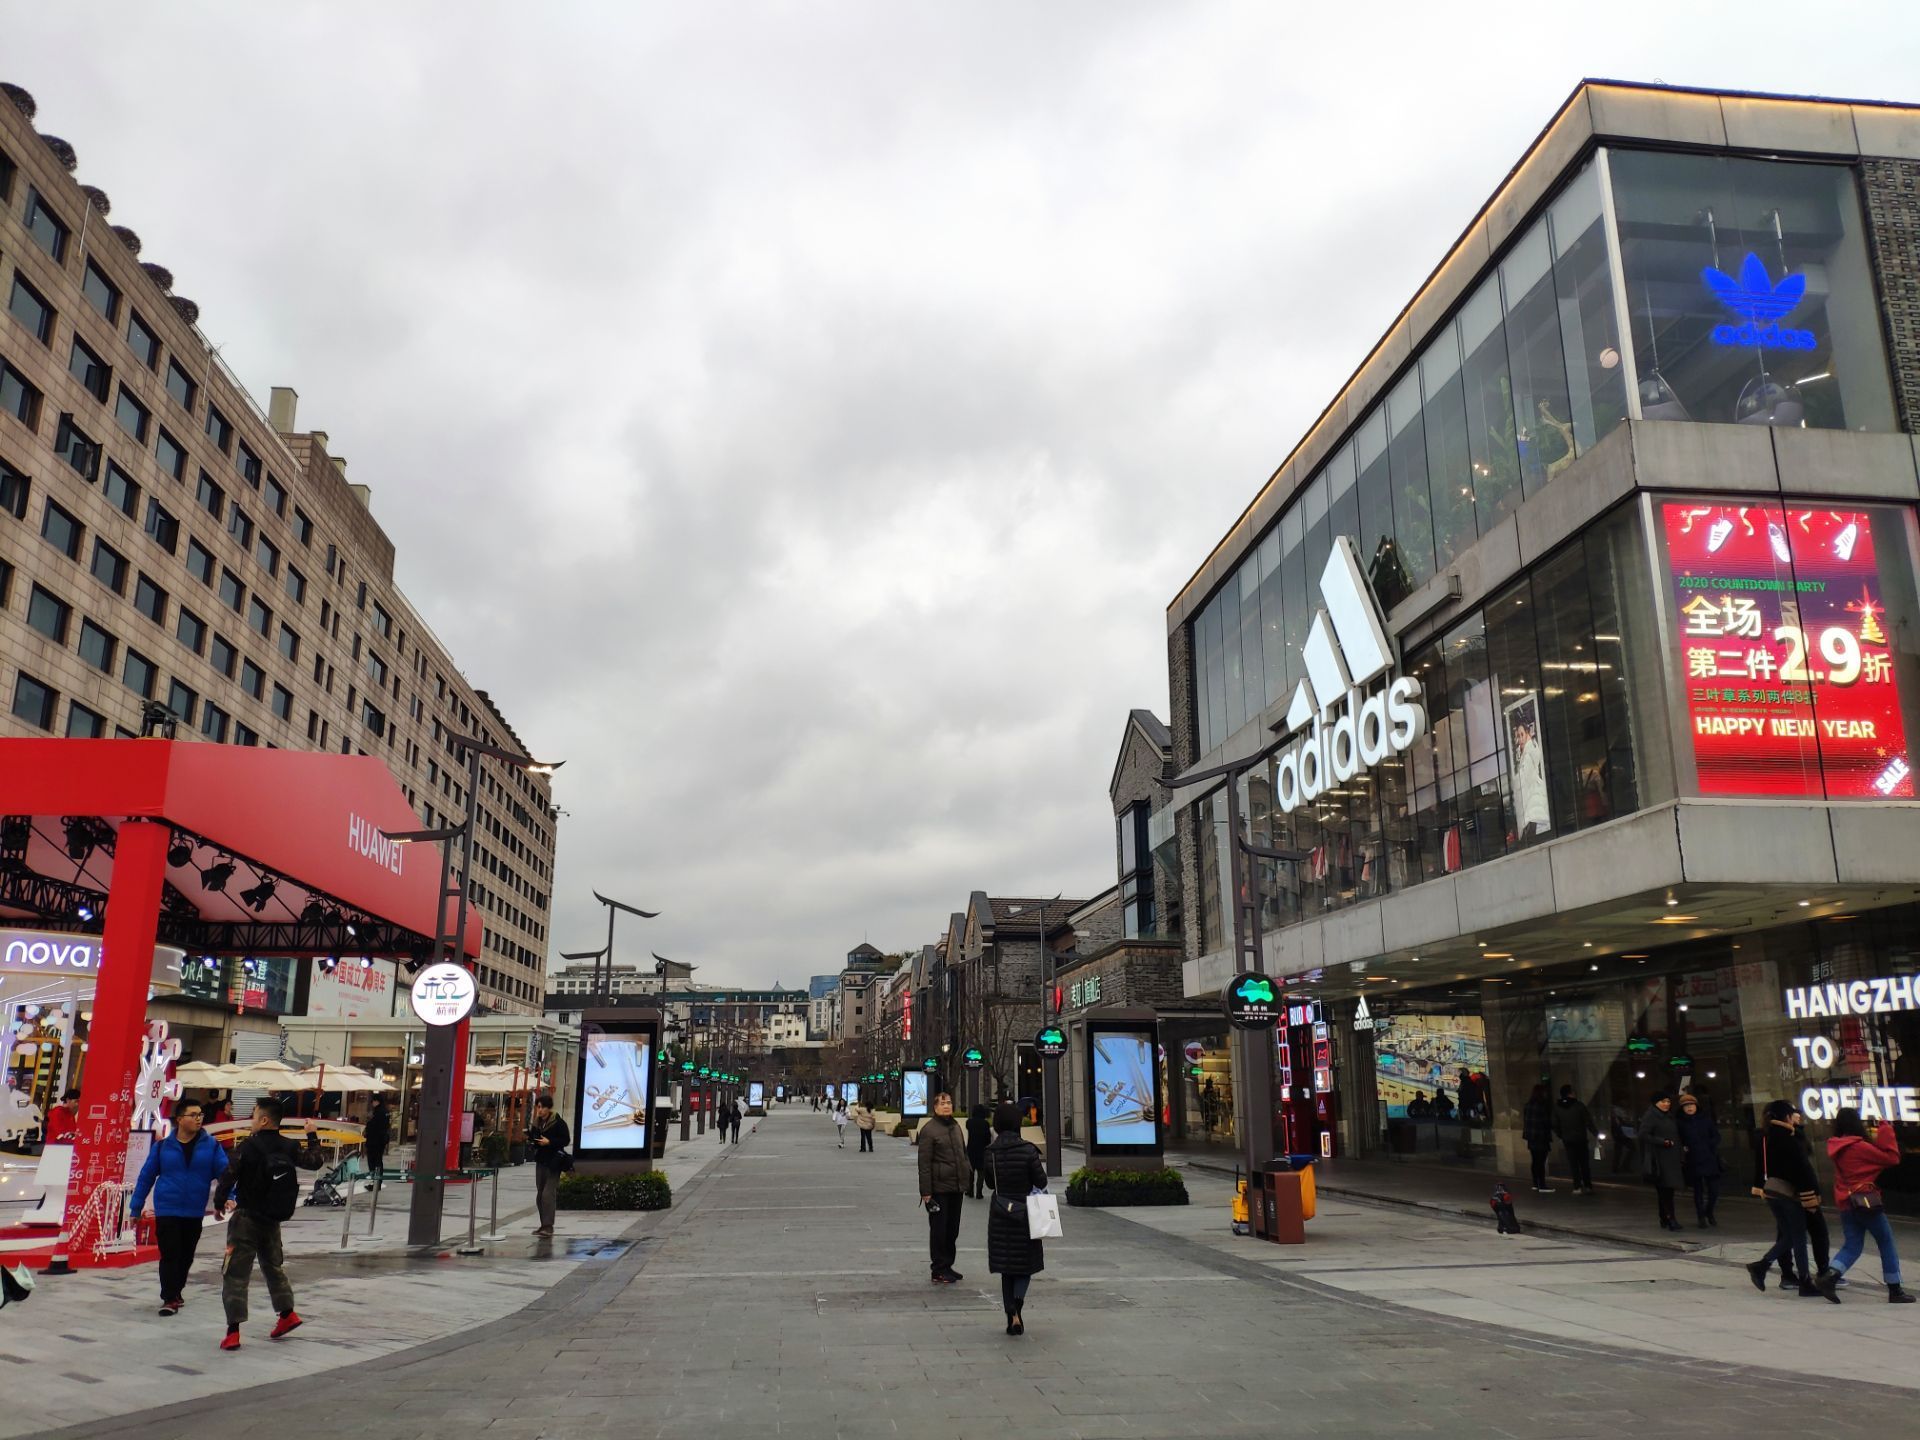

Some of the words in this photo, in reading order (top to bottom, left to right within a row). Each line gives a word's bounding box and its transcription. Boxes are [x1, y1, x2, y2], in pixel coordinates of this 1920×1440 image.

[1712, 322, 1817, 352] adidas
[1679, 576, 1709, 588] 2020
[1711, 578, 1785, 591] COUNTDOWN
[1787, 579, 1826, 592] PARTY
[1682, 594, 1762, 637] 全场
[1695, 716, 1766, 736] HAPPY
[1771, 718, 1815, 737] NEW
[1822, 720, 1877, 739] YEAR
[1278, 677, 1425, 813] adidas
[1873, 757, 1910, 795] SALE
[349, 812, 403, 876] HUAWEI
[5, 940, 91, 968] nova
[1354, 1017, 1374, 1031] adidas
[1793, 1036, 1834, 1069] TO
[119, 1089, 130, 1102] 5G
[1802, 1086, 1920, 1122] CREATE
[116, 1151, 126, 1164] 5G
[69, 1169, 83, 1179] 5G
[67, 1204, 82, 1215] 5G
